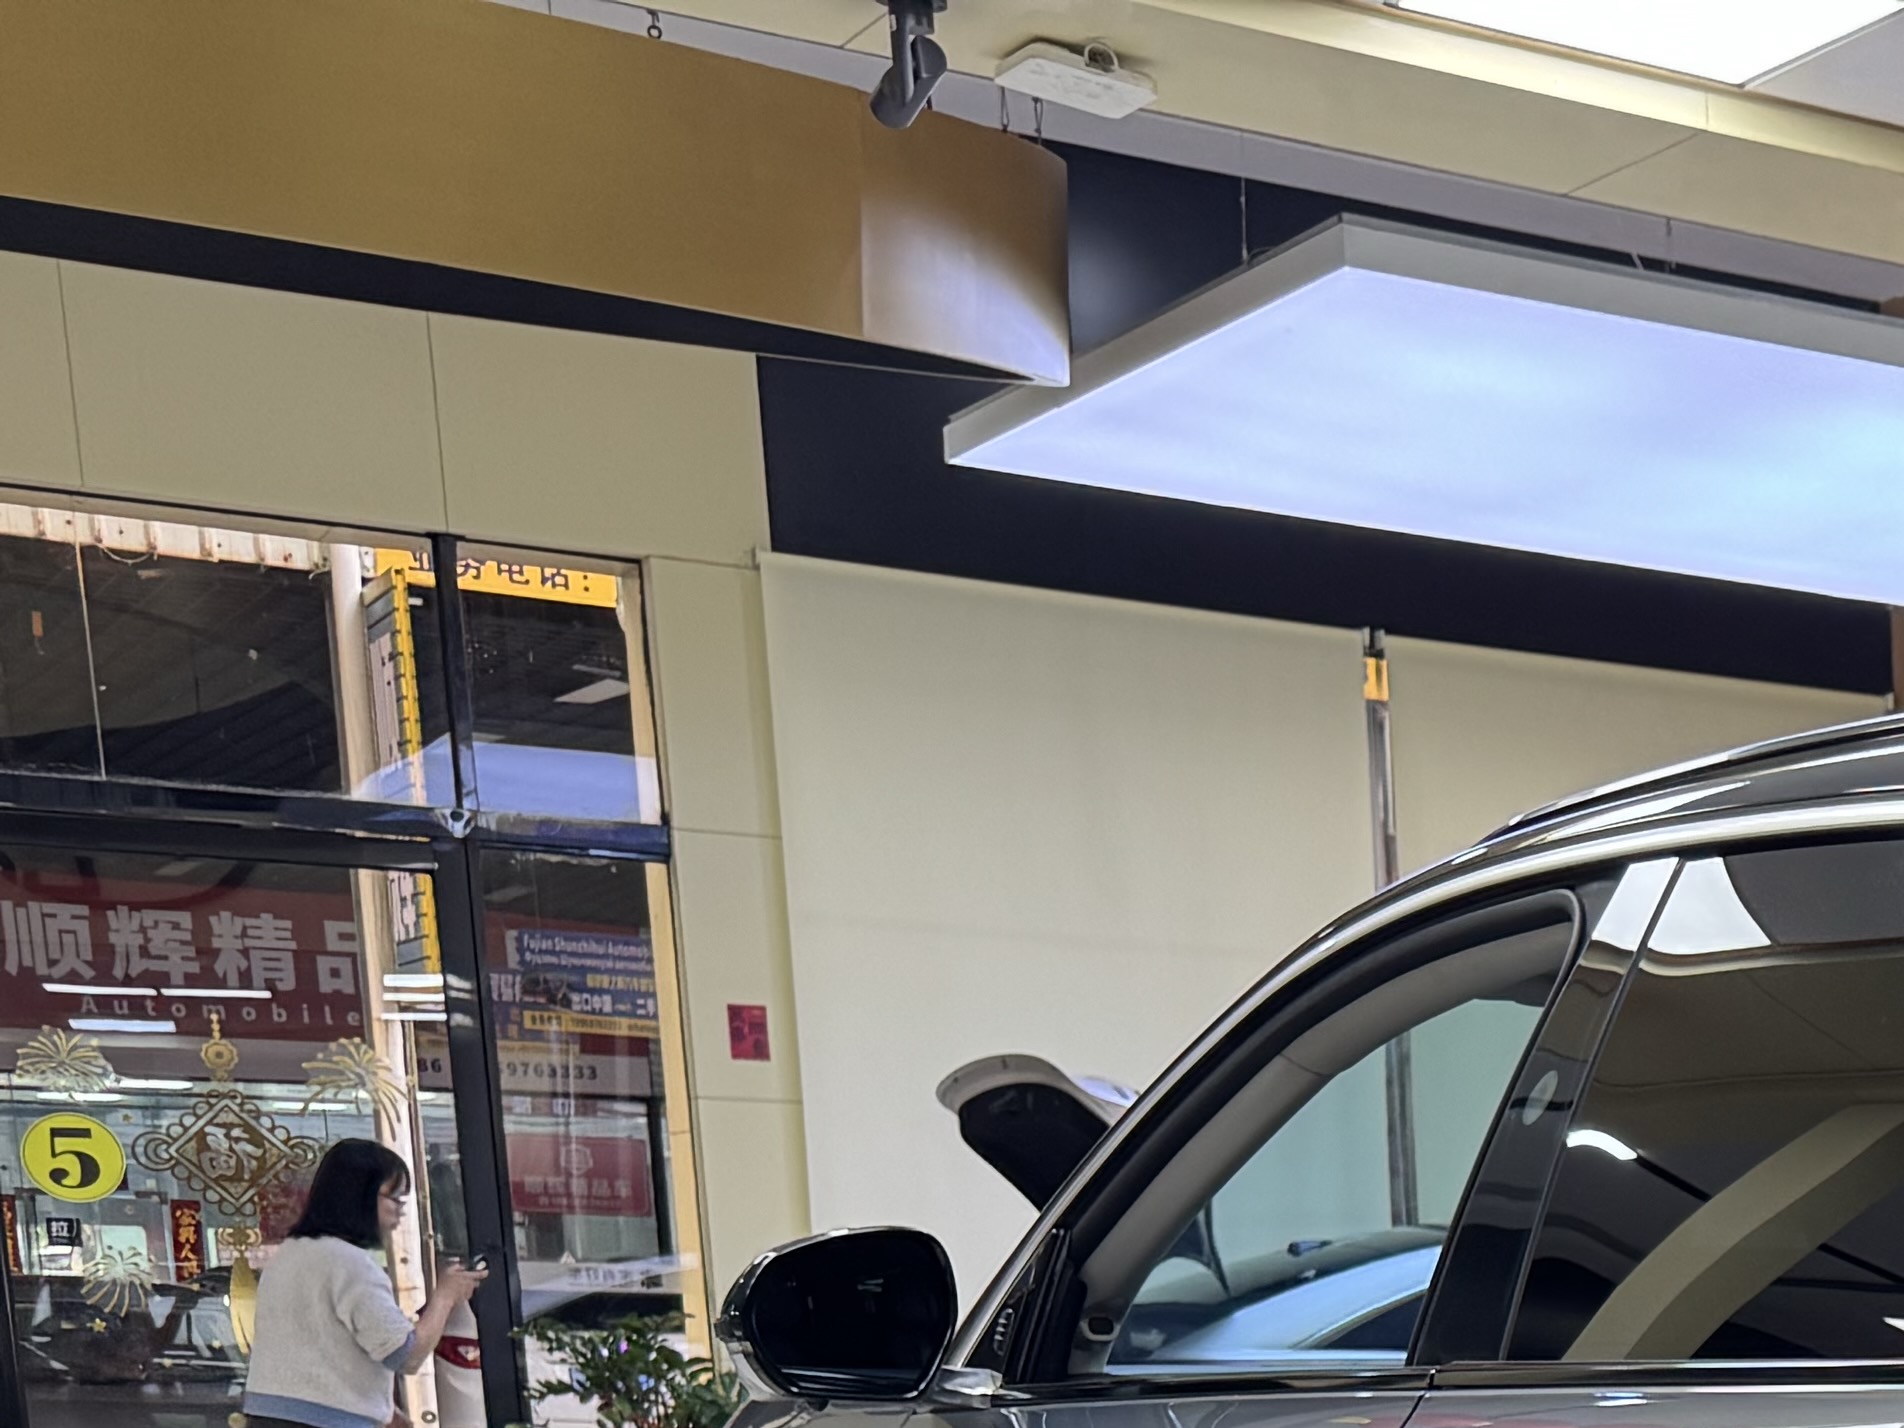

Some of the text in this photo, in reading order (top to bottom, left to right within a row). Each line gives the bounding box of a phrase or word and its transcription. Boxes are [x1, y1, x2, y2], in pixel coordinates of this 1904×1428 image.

[3, 900, 359, 995] 顺辉精品
[81, 996, 361, 1027] Automobile
[48, 1127, 101, 1189] 5
